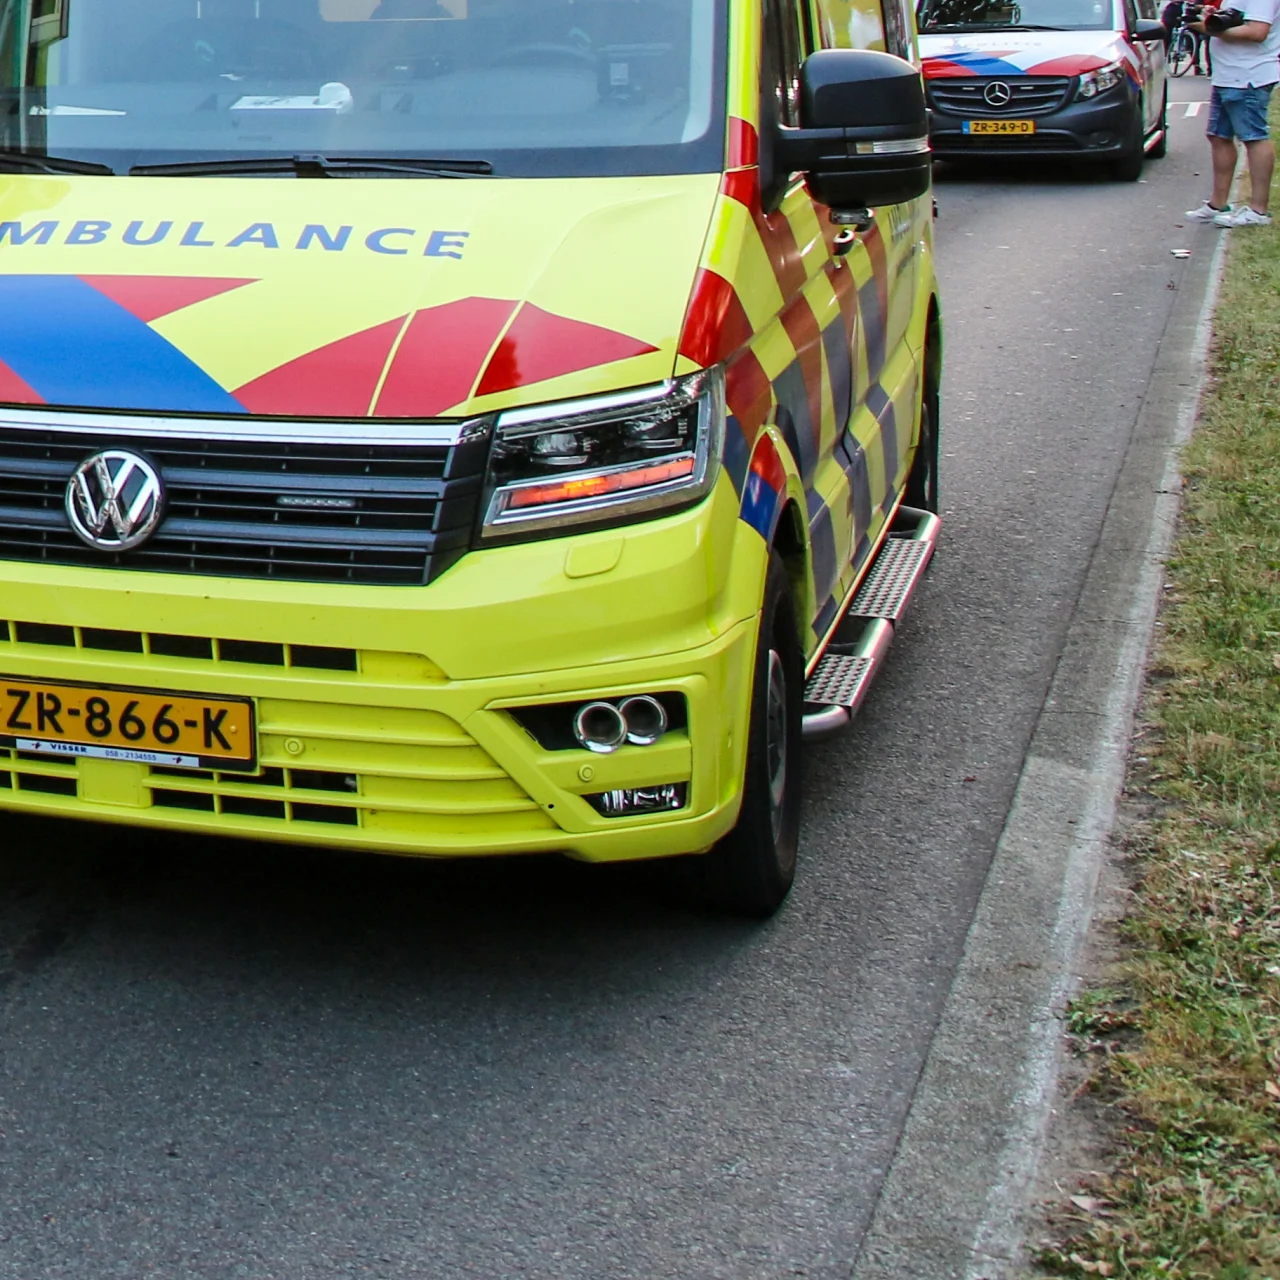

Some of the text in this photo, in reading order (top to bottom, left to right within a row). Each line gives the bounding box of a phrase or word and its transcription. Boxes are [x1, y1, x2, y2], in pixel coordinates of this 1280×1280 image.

[973, 122, 1029, 132] ZR-349-D
[5, 688, 232, 751] ZR-866-K
[50, 742, 87, 753] VISSER
